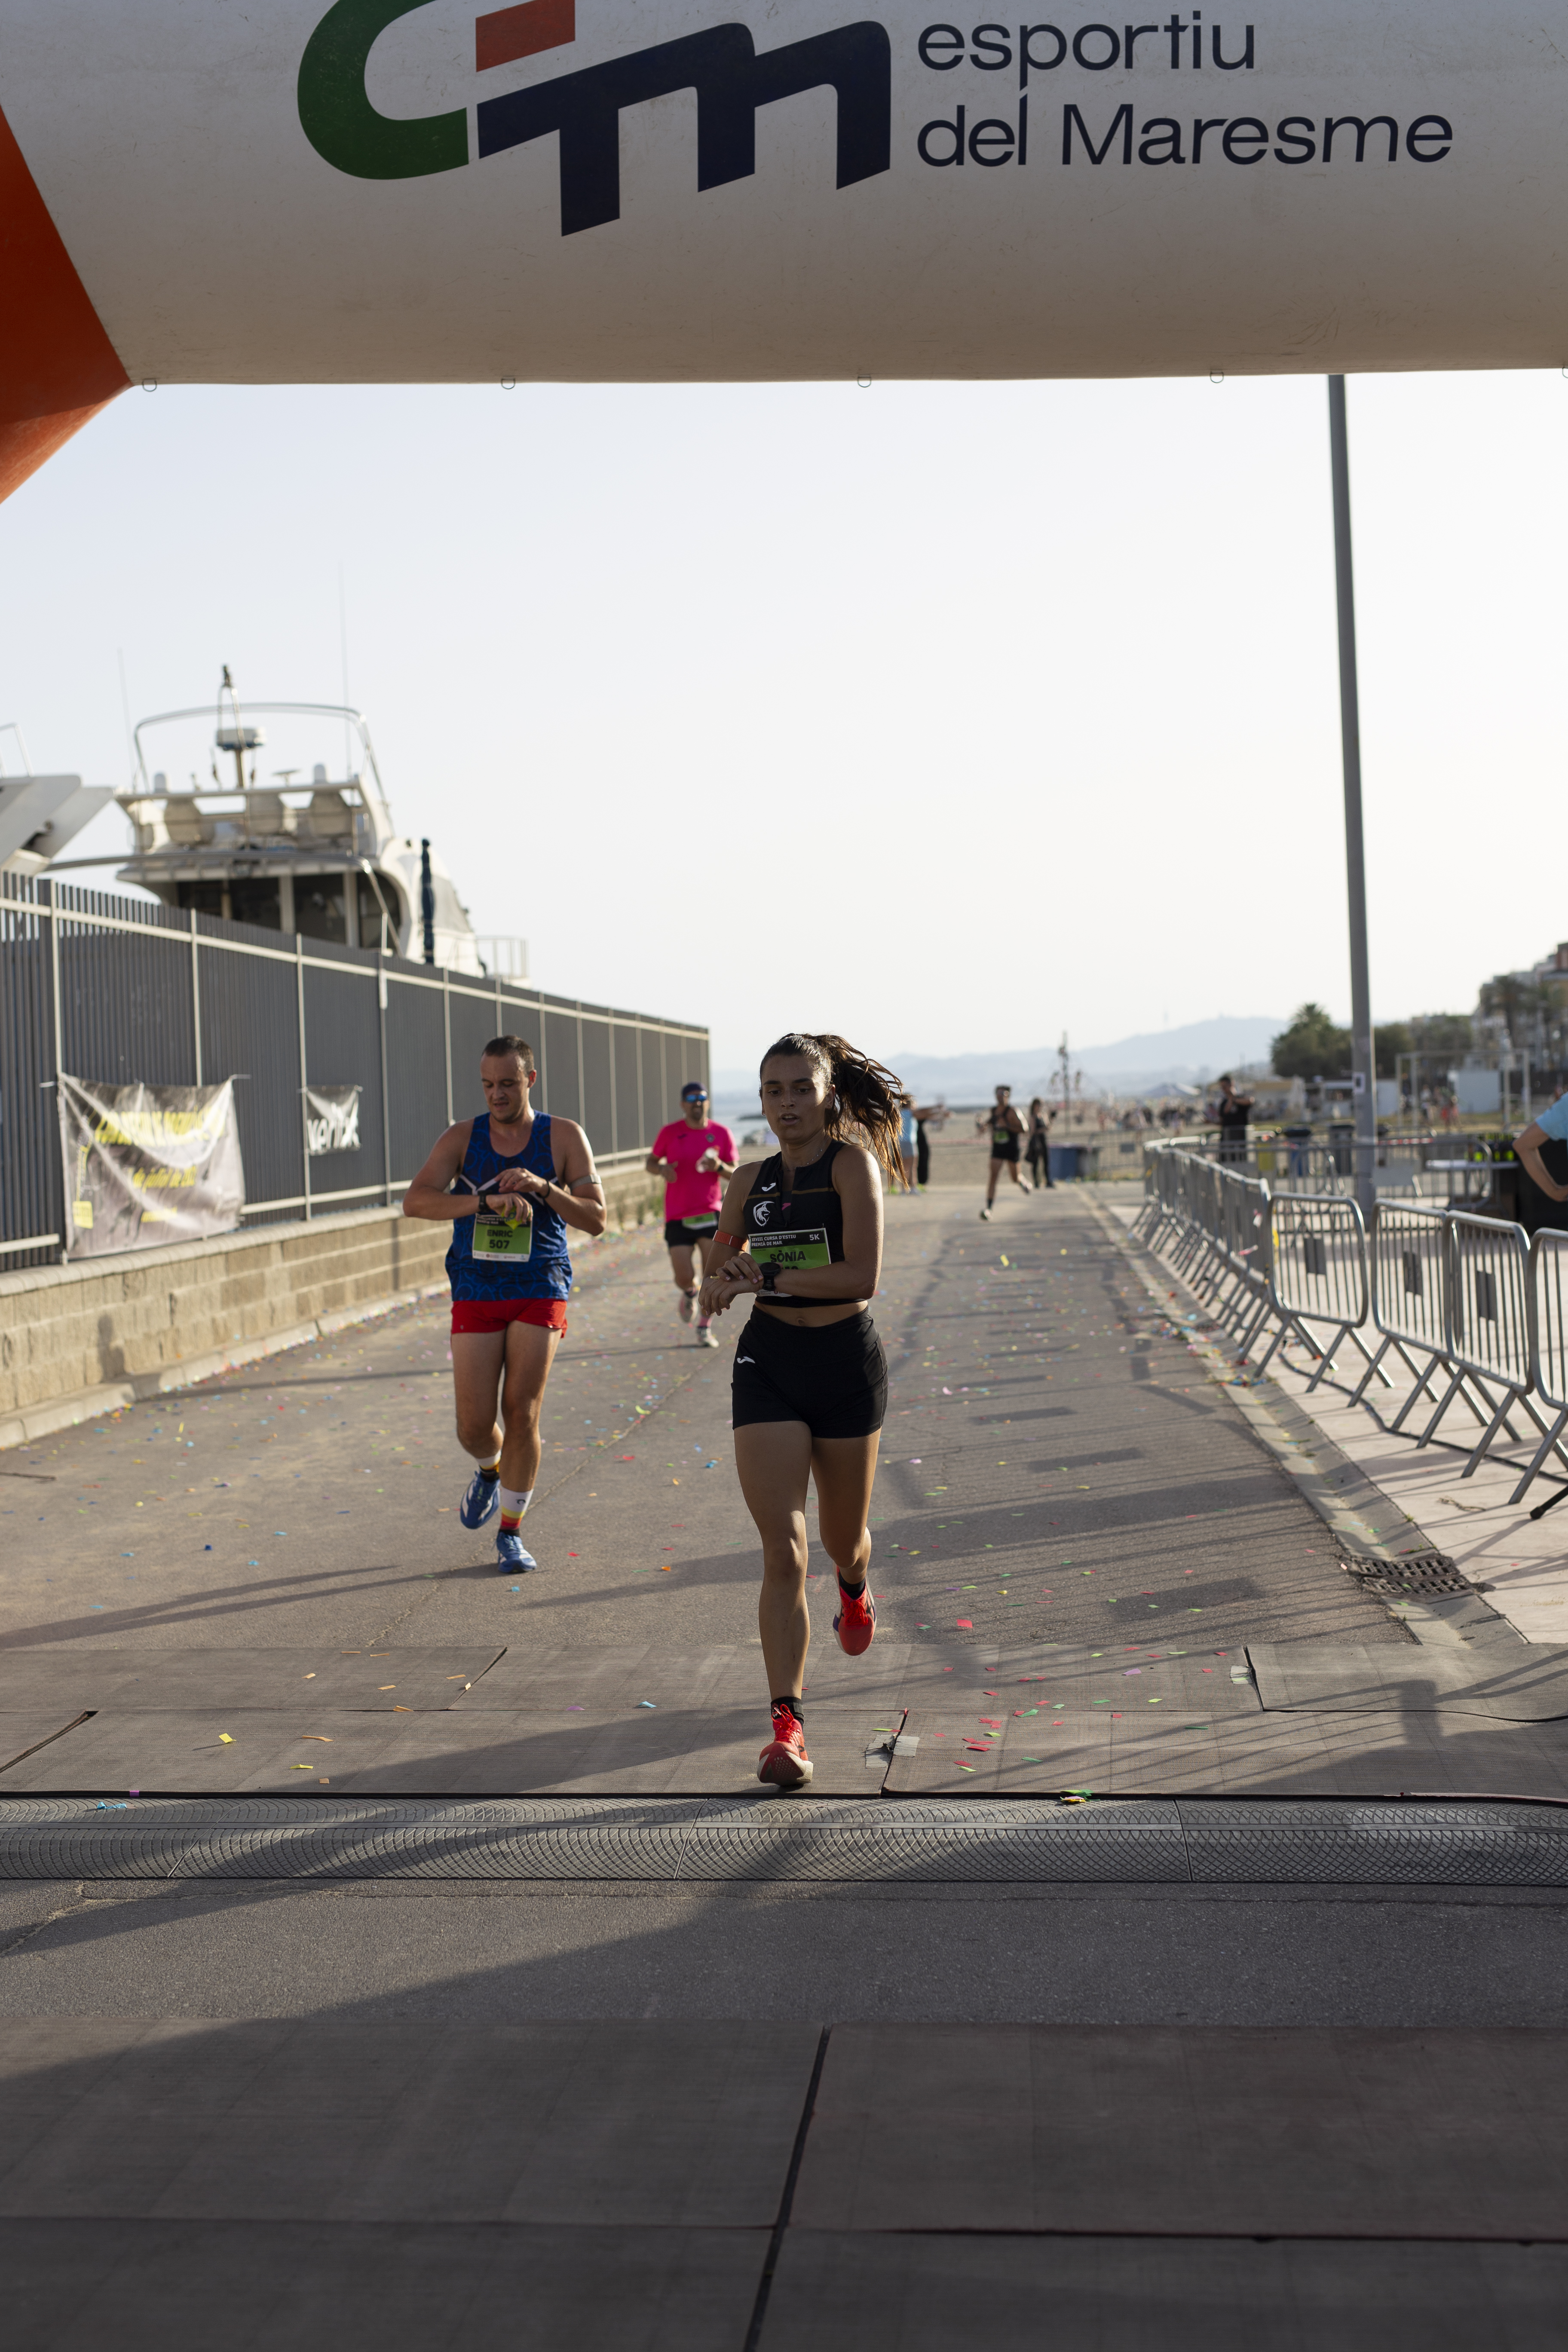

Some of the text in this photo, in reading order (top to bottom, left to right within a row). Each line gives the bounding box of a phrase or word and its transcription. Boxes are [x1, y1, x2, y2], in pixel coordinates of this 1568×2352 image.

[917, 10, 1255, 91] esportiu
[917, 93, 1453, 167] del Maresme
[487, 1229, 513, 1237] ENRIC
[489, 1239, 510, 1249] 507
[770, 1250, 806, 1262] SÒNIA
